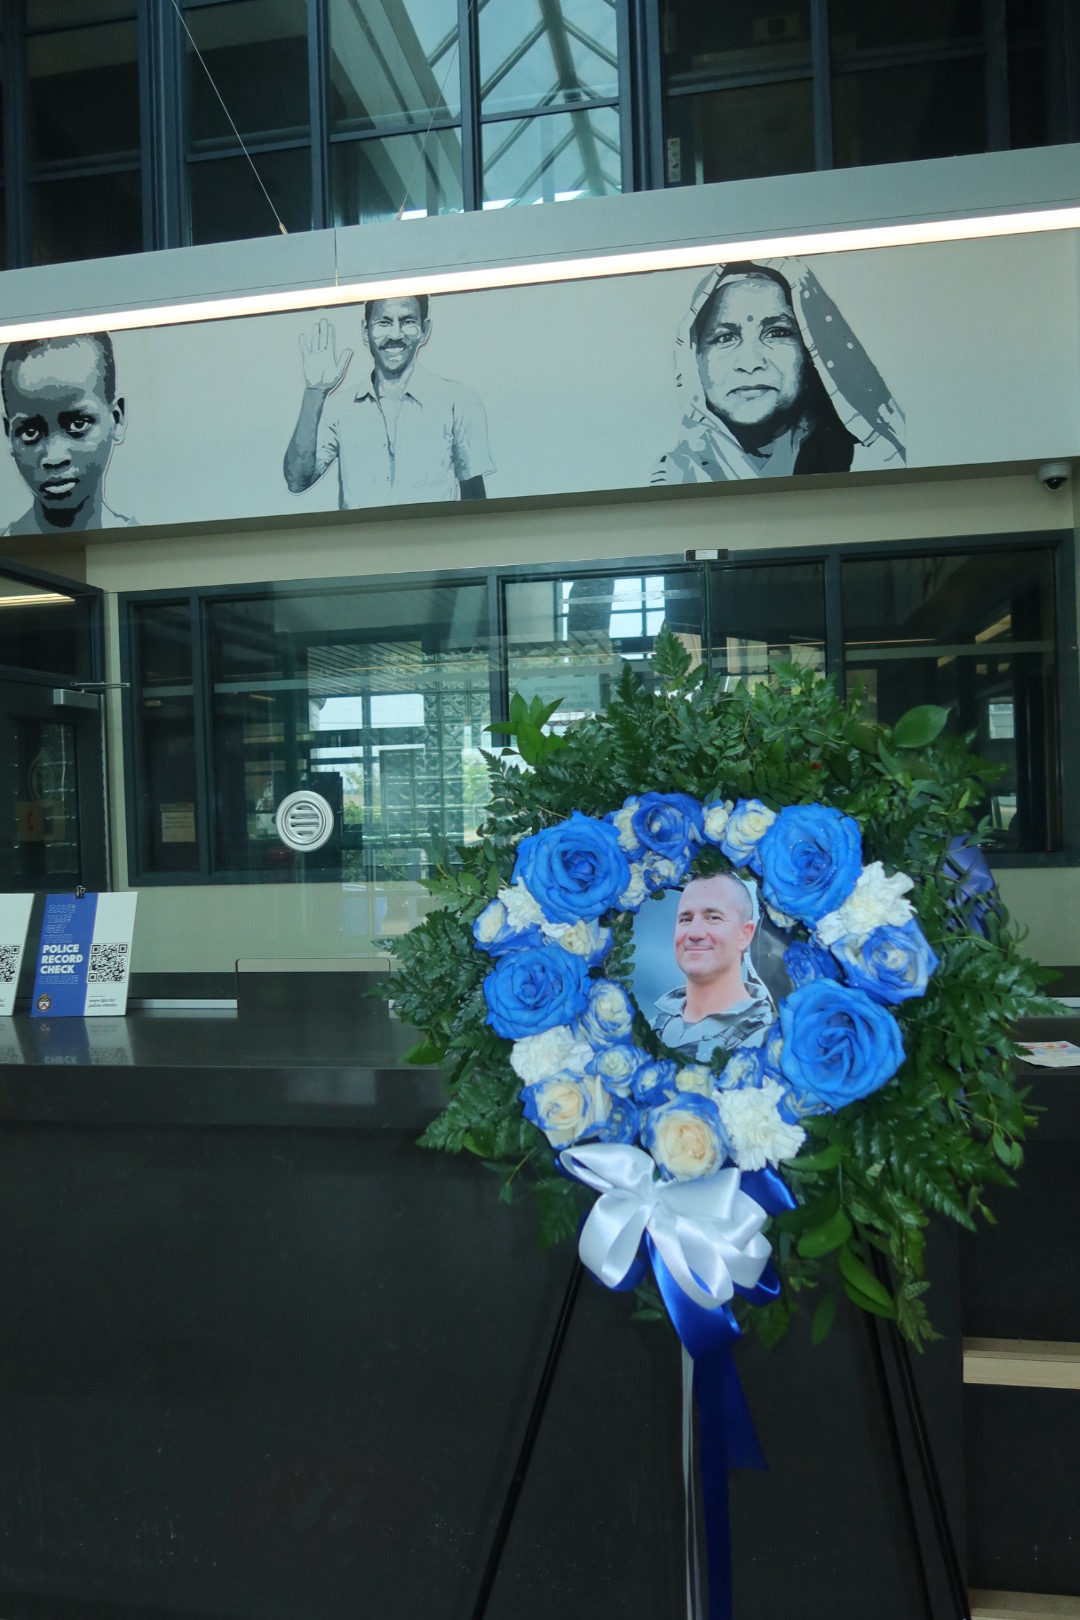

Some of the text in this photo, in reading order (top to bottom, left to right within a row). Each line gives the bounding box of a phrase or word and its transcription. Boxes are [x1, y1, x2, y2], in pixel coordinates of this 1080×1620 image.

[48, 904, 76, 914] SAVE
[47, 914, 72, 924] TIME
[46, 924, 66, 934] GET
[44, 934, 73, 943] YOUR
[42, 944, 80, 954] POLICE
[41, 954, 84, 964] RECORD
[40, 964, 75, 974] CHECK
[39, 975, 79, 985] ONLINE
